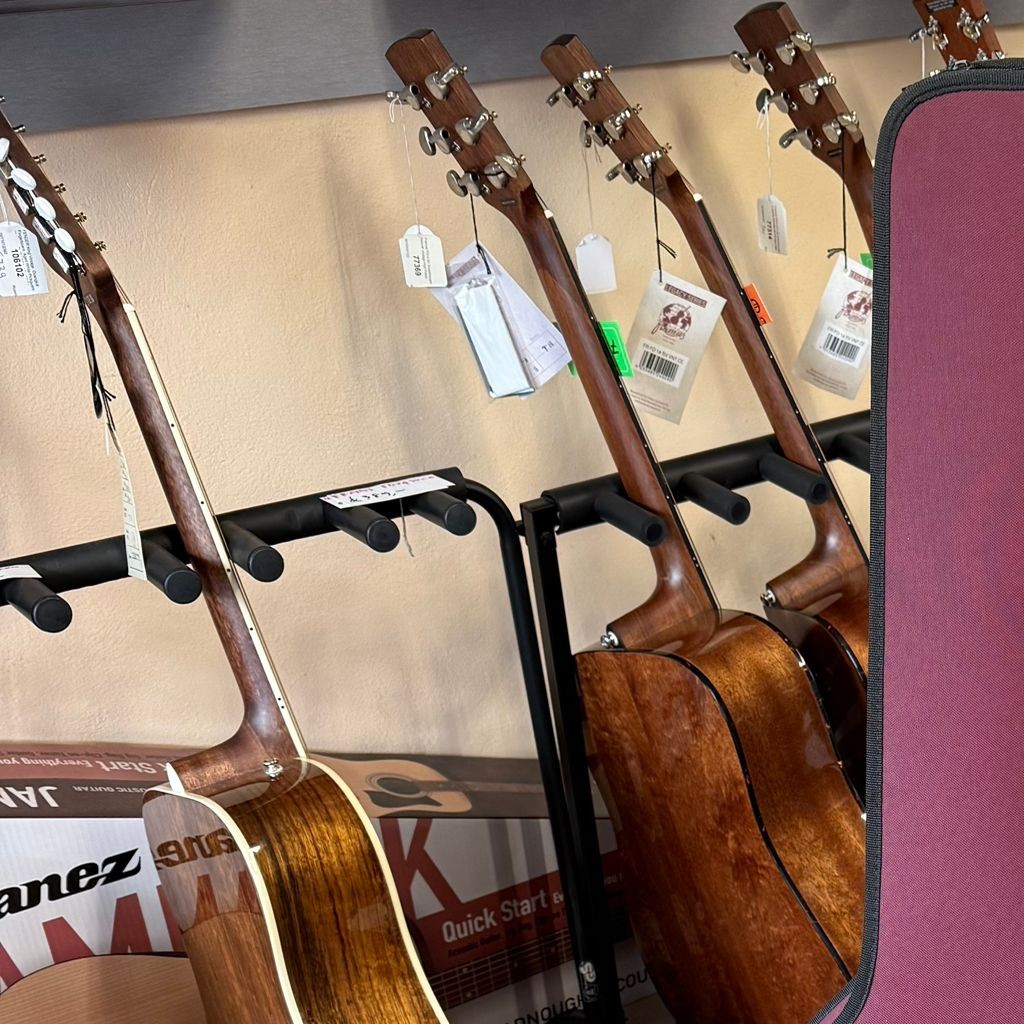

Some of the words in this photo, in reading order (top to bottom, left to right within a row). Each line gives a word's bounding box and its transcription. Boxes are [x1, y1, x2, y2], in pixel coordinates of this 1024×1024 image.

[11, 249, 24, 278] 106102
[412, 255, 421, 277] 77369
[21, 757, 93, 768] Everything
[96, 760, 157, 773] Start
[73, 785, 115, 793] GUITAR
[0, 848, 141, 919] anez
[442, 907, 497, 943] Quick
[501, 888, 548, 923] Start
